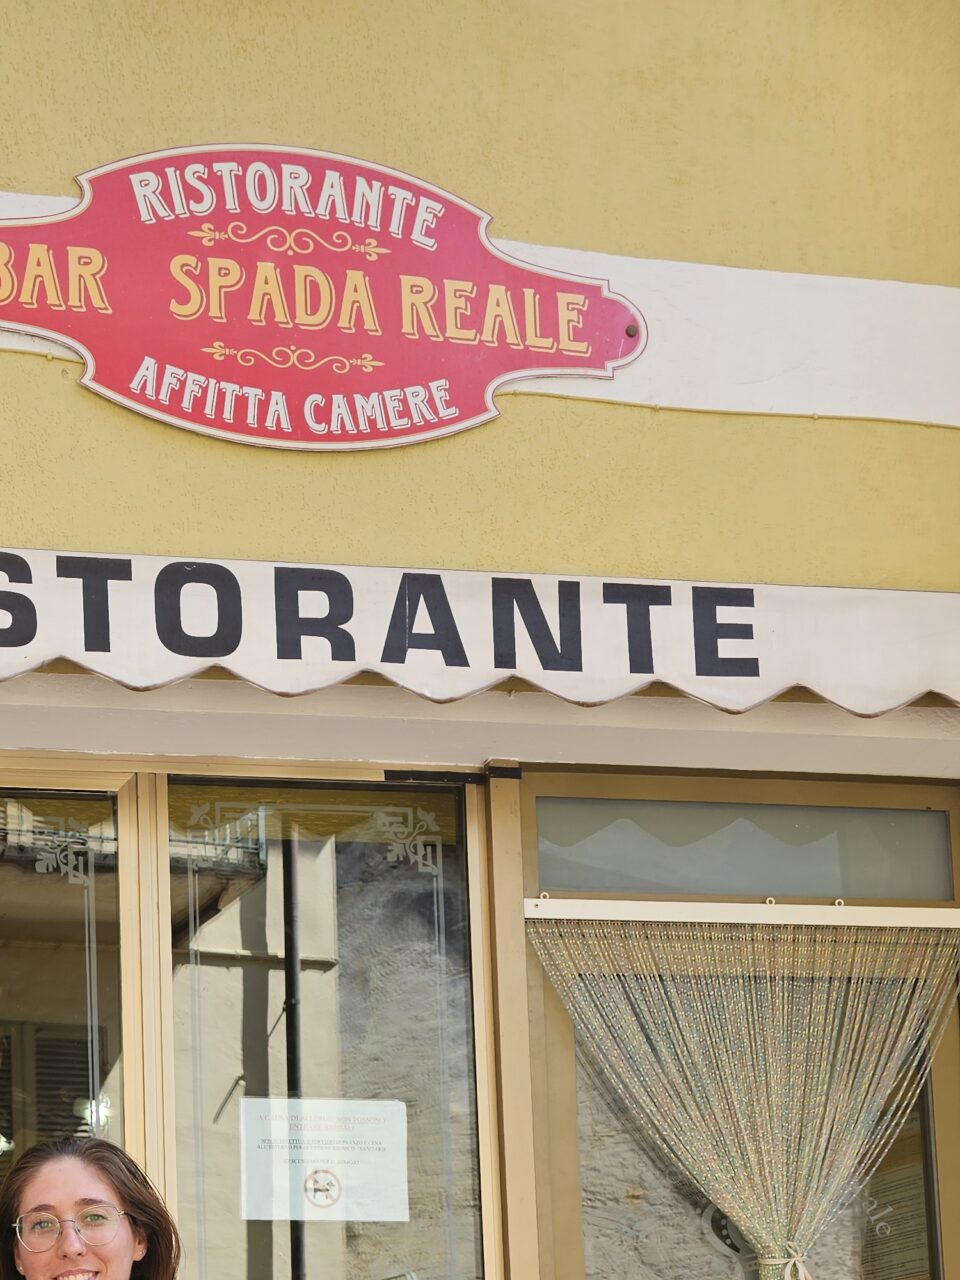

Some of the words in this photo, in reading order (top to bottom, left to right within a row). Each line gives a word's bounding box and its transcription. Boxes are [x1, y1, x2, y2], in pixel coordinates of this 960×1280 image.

[129, 161, 444, 251] RISTORANTE
[168, 254, 381, 336] SPADA
[399, 274, 591, 358] REALE
[129, 356, 292, 432] AFFITTA
[303, 379, 459, 434] CAMERE
